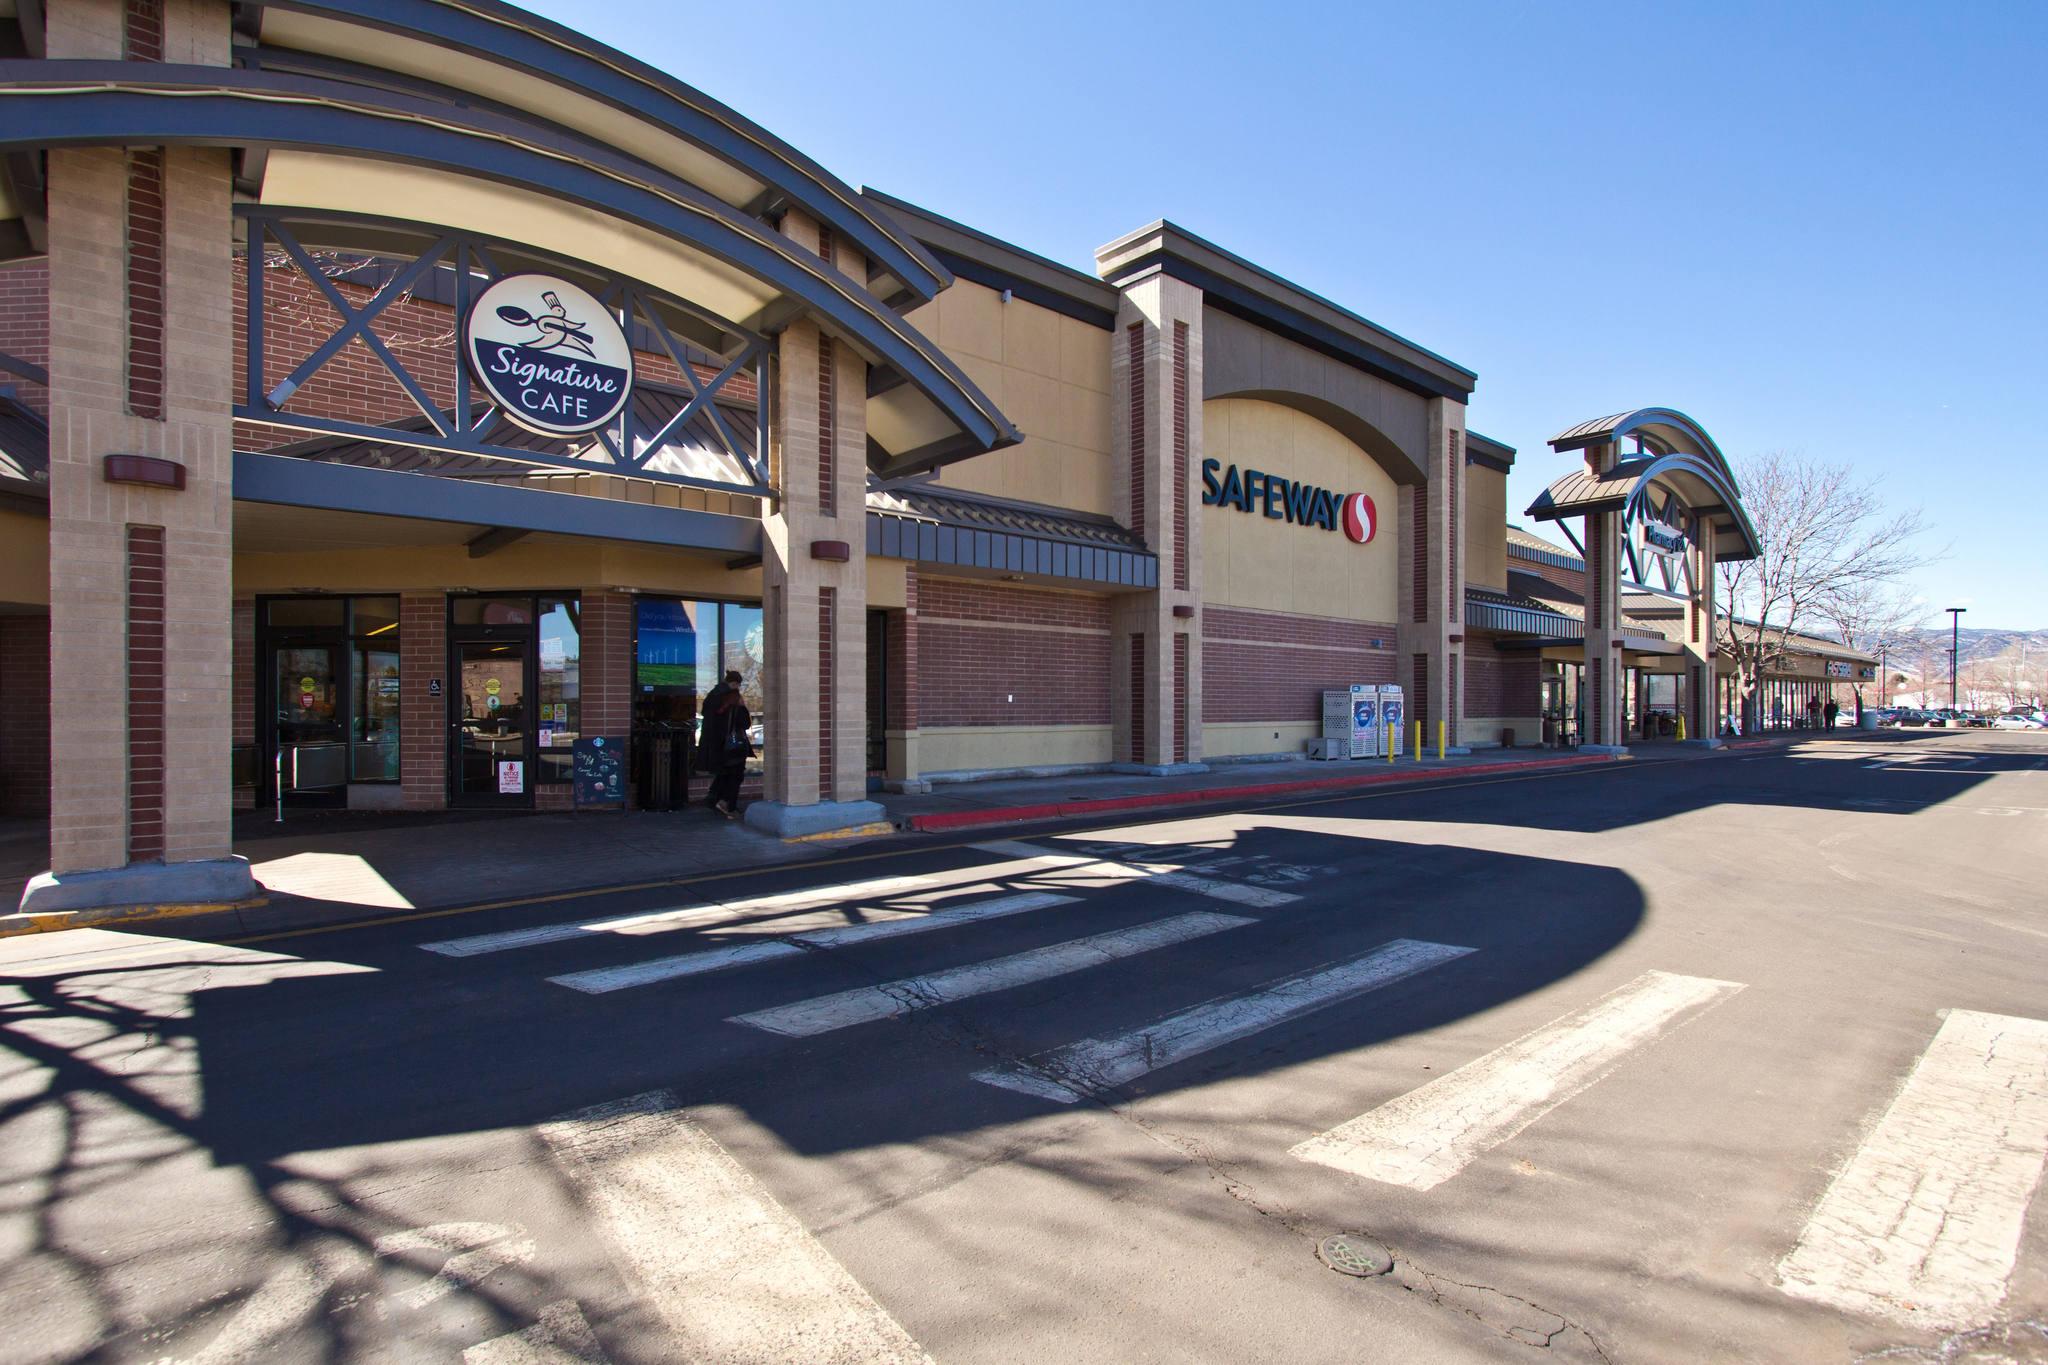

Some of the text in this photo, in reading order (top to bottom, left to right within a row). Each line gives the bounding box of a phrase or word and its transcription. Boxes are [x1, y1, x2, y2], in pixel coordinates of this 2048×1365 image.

[490, 347, 617, 393] Signature
[521, 388, 588, 418] CAFE
[1202, 458, 1344, 531] SAFEWAY
